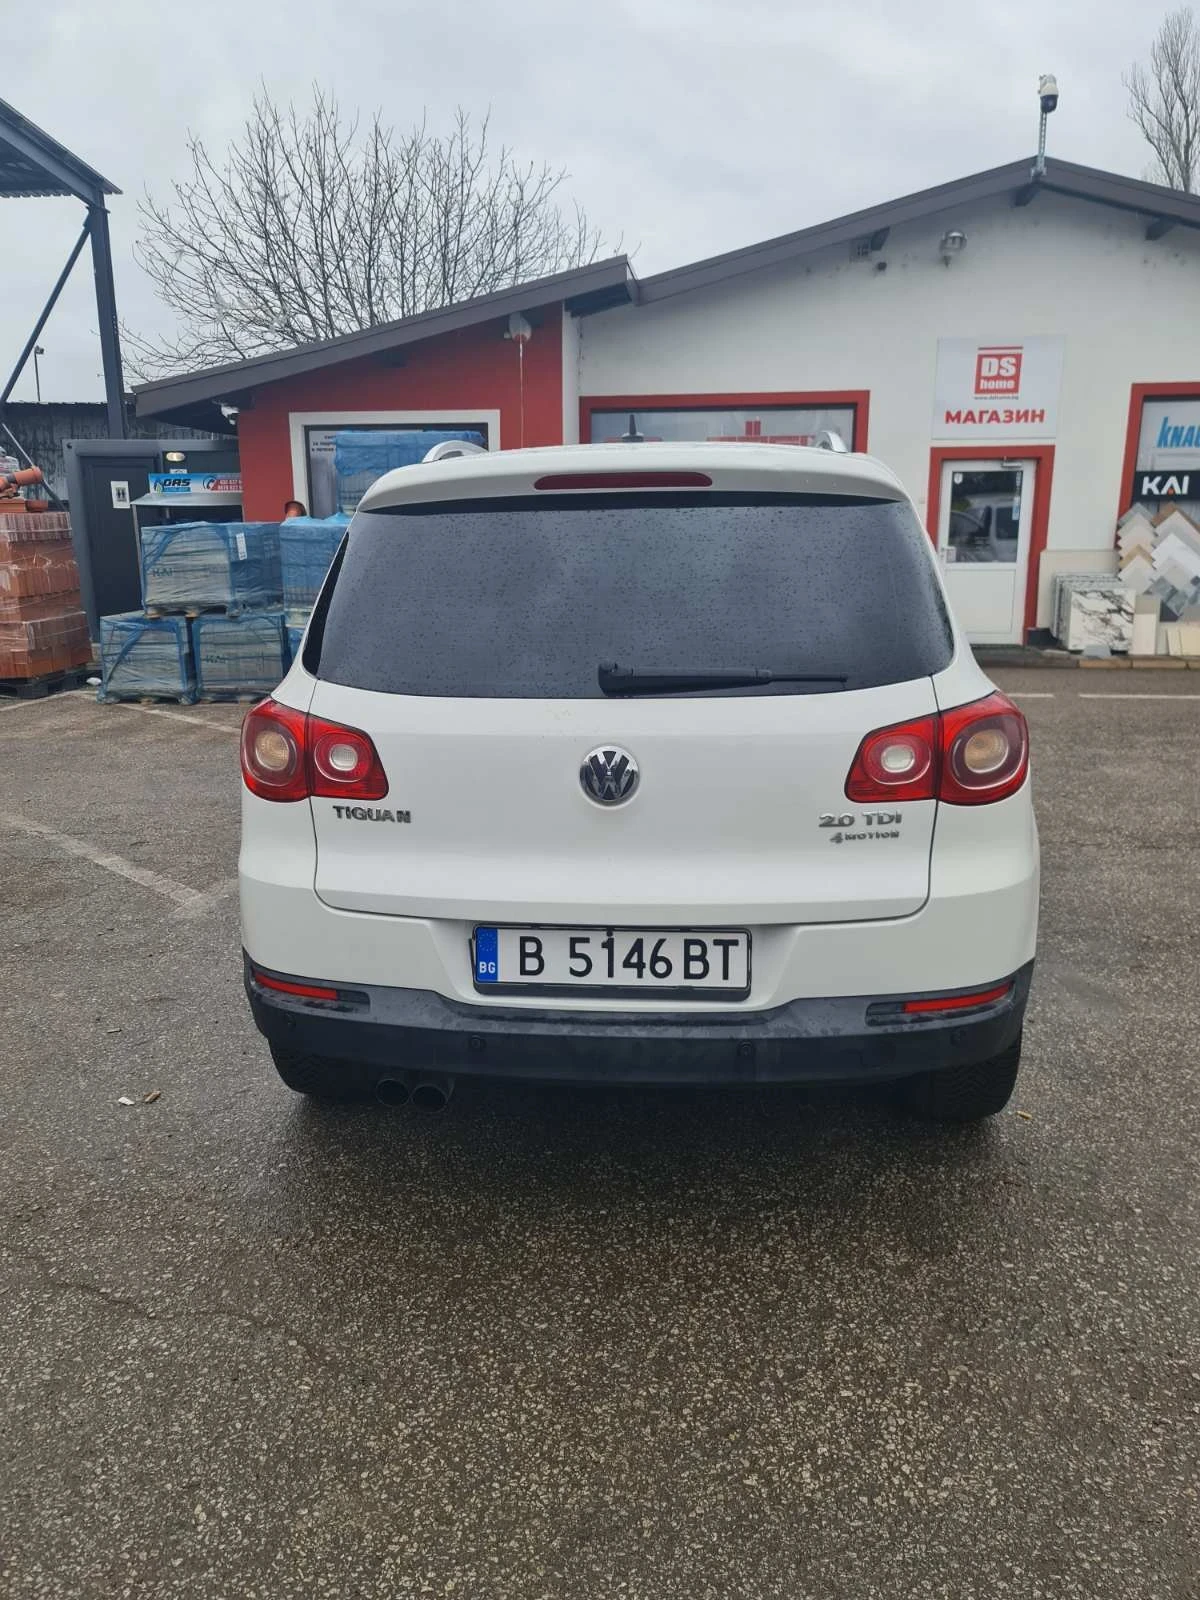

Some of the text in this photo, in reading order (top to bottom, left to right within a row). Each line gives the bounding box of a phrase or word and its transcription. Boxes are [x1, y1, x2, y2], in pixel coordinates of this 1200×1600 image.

[981, 357, 1017, 377] DS
[980, 379, 1015, 390] home
[945, 408, 1045, 424] МАГАЗИН
[1141, 475, 1190, 495] KAI
[332, 805, 412, 823] TIGUAN
[862, 810, 903, 826] TDI
[519, 936, 739, 981] B 5146 BT
[479, 962, 496, 974] BG
